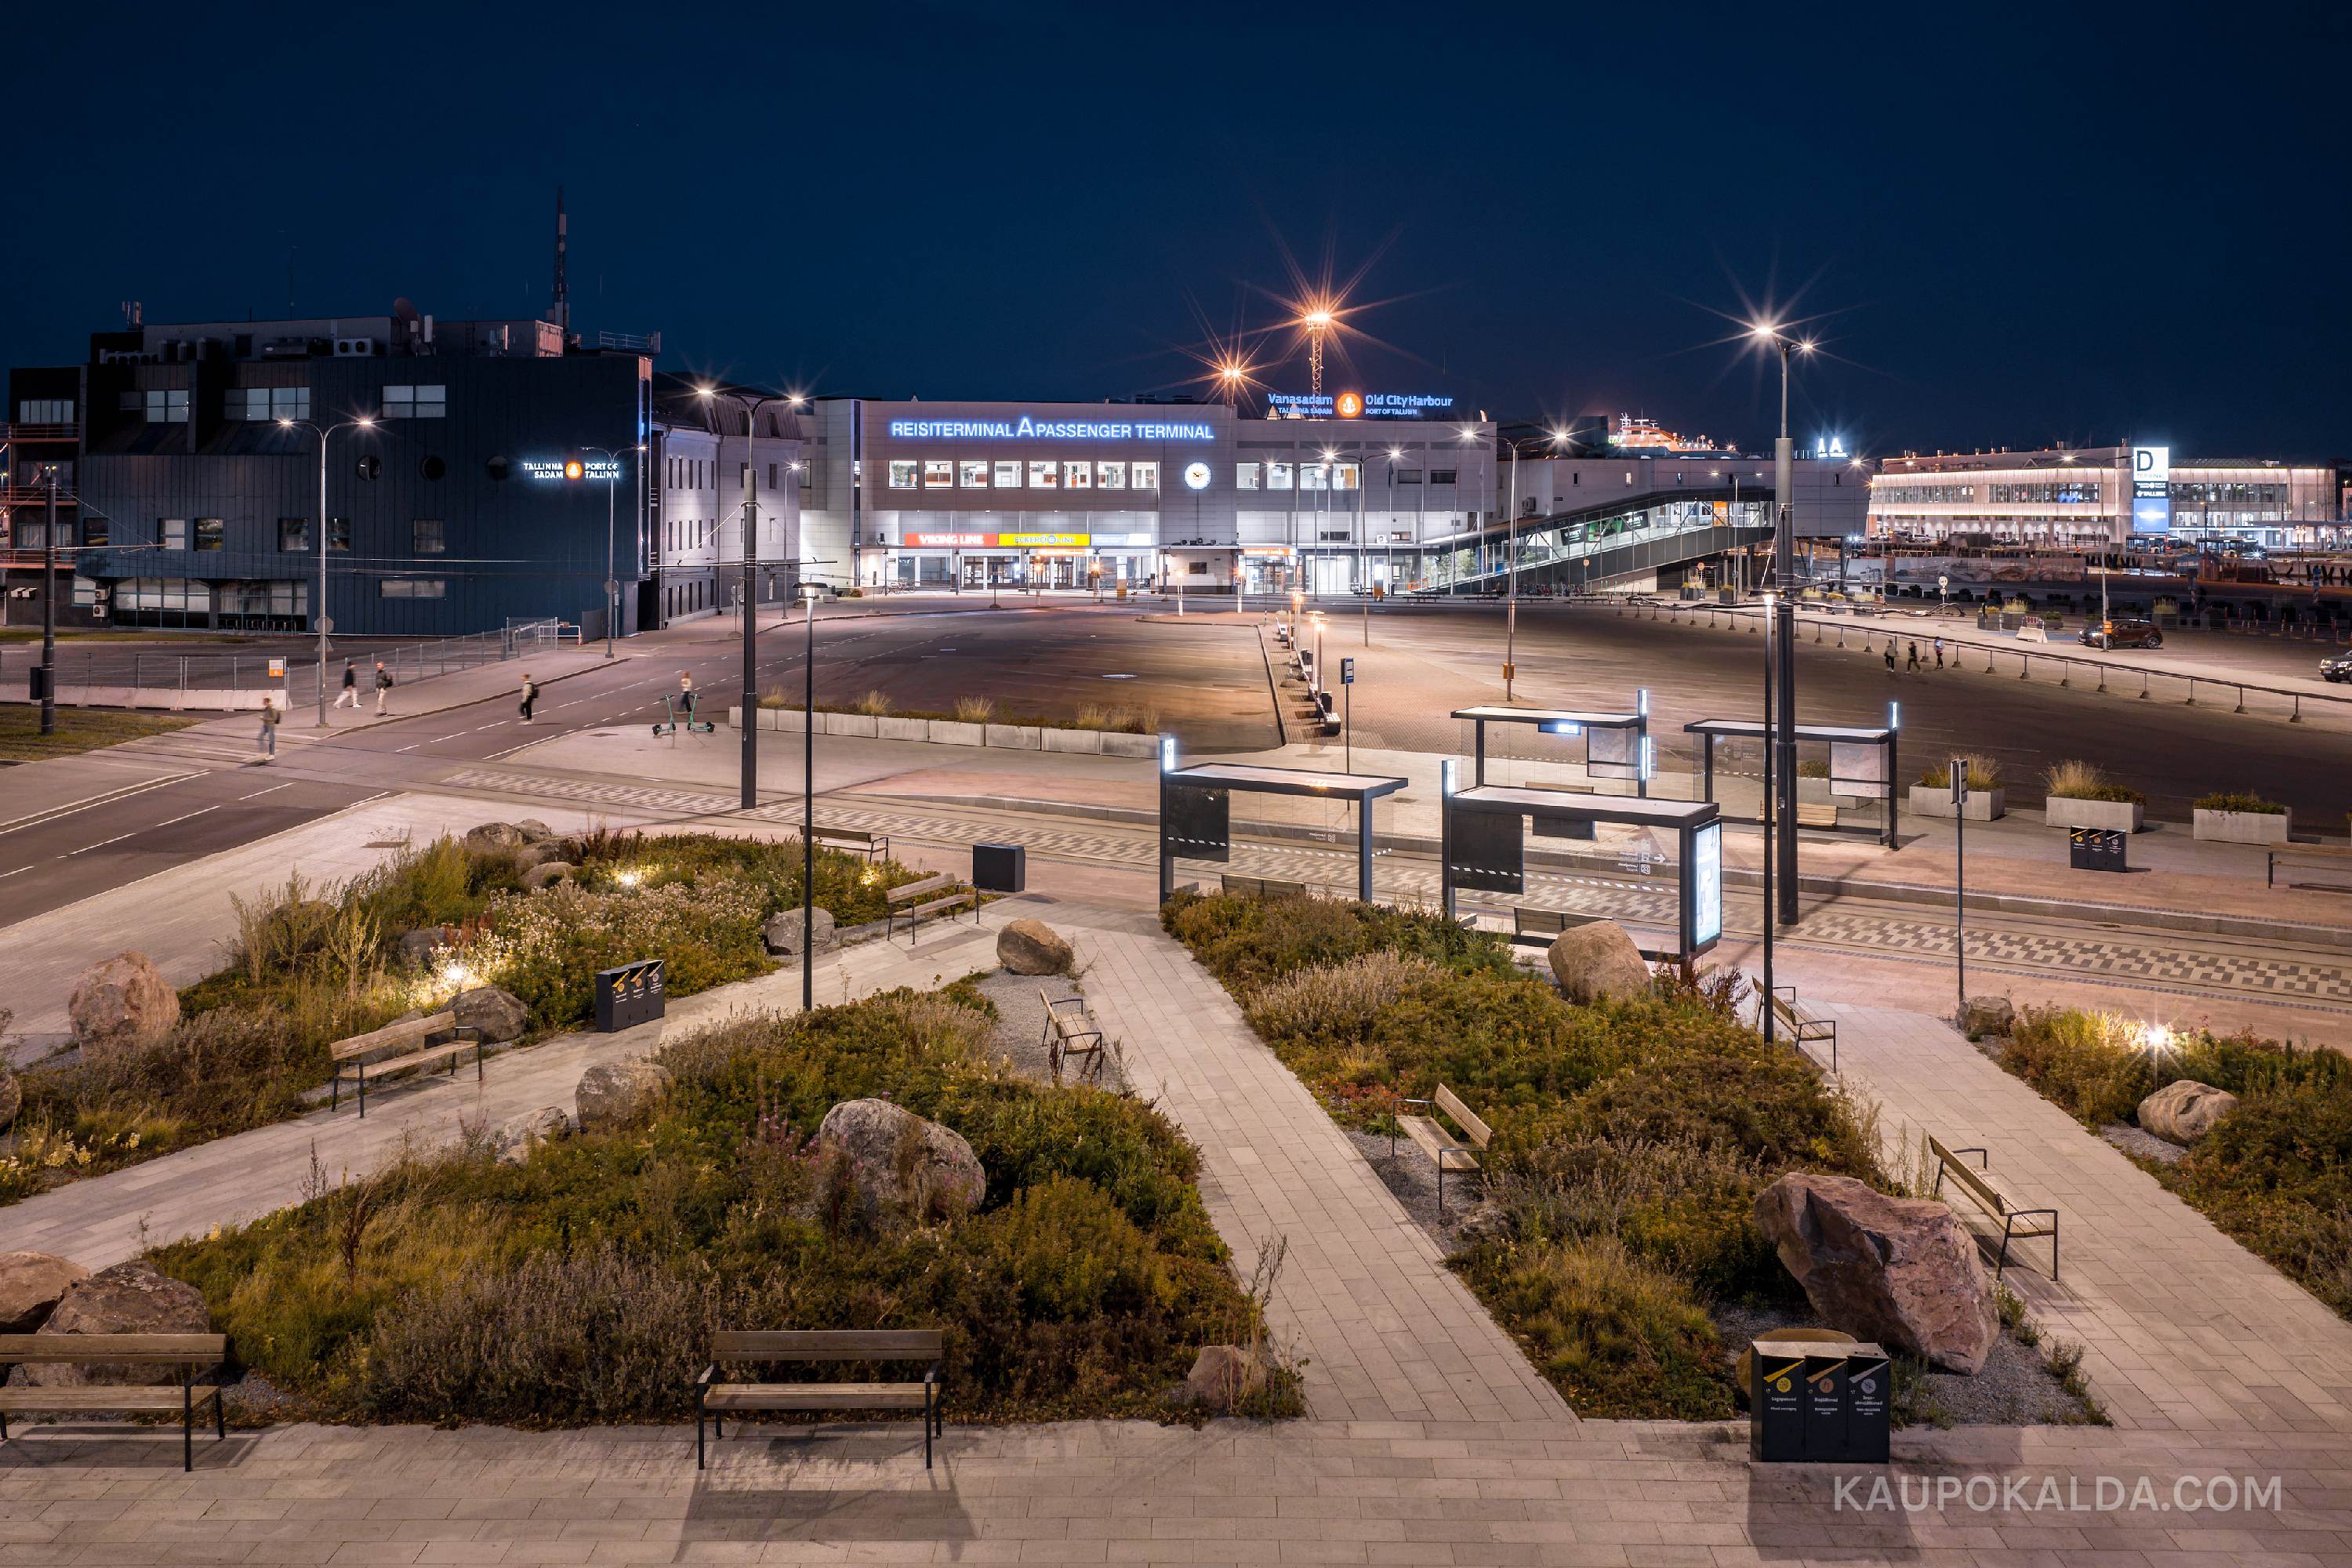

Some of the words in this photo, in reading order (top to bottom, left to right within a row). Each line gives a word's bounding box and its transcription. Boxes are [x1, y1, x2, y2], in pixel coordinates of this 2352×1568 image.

[1268, 394, 1333, 405] Vanasadam
[1365, 394, 1384, 405] Old
[1386, 395, 1409, 408] City
[1409, 395, 1453, 406] Harbour
[892, 422, 1014, 437] REISITERMINAL
[1017, 416, 1036, 437] A
[1036, 423, 1132, 437] PASSENGER
[1134, 424, 1214, 439] TERMINAL
[2136, 450, 2154, 471] D
[918, 535, 958, 544] VIKING
[959, 535, 984, 544] LINE
